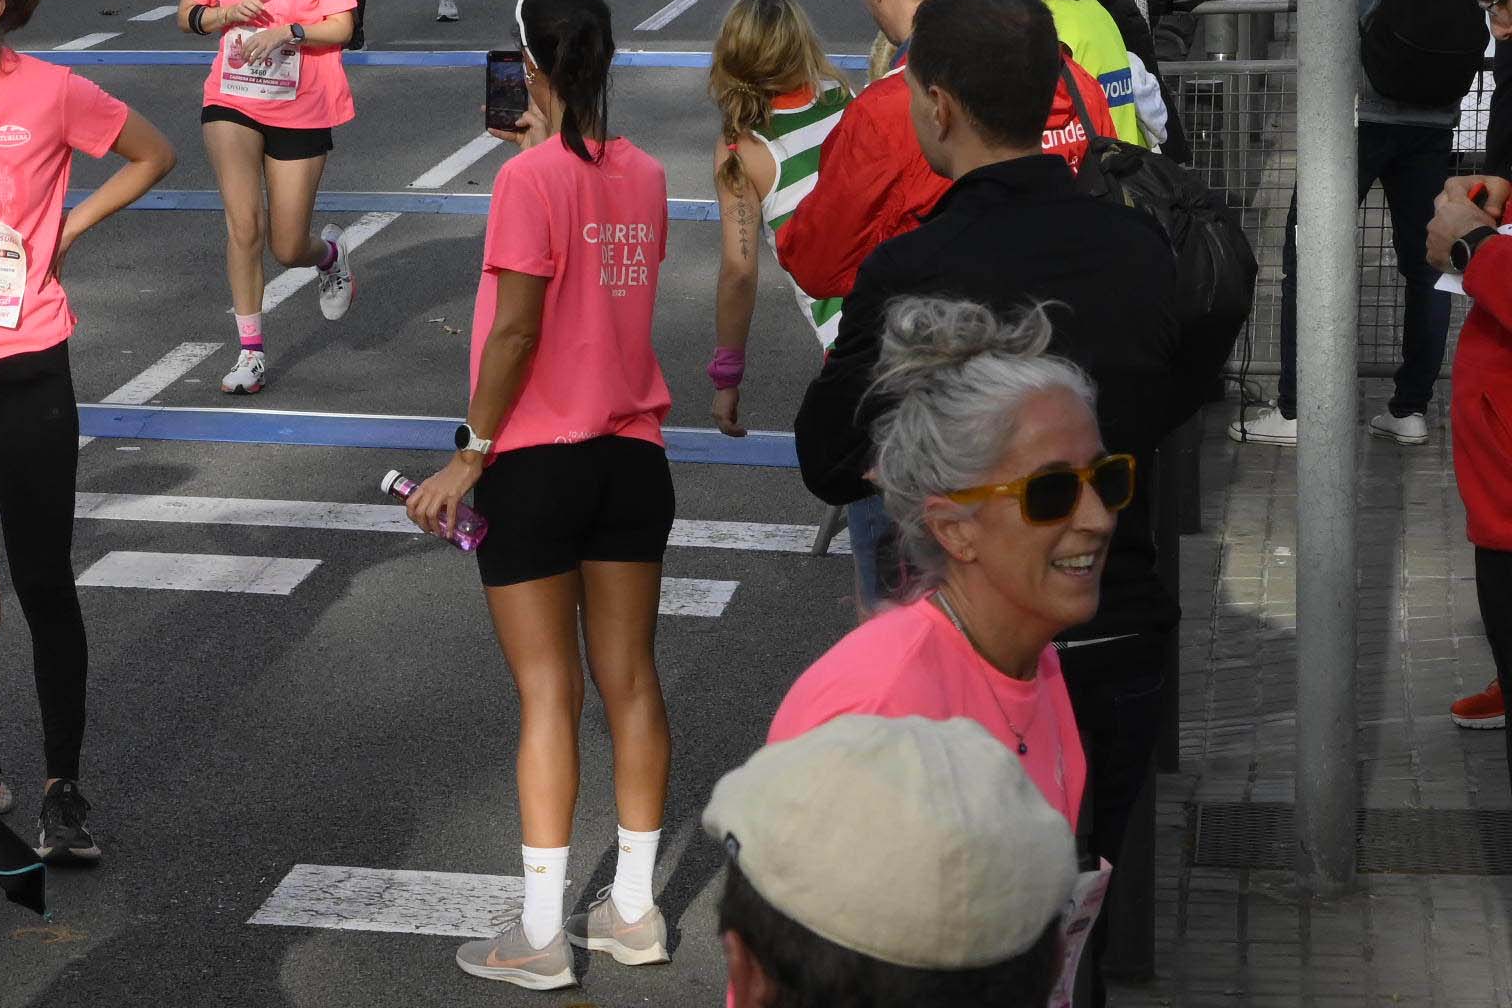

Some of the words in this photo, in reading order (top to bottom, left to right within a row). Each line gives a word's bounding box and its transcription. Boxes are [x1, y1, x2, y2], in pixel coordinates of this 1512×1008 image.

[1042, 121, 1086, 149] ande
[583, 223, 655, 244] CARRERA
[601, 245, 614, 264] DE
[623, 244, 646, 265] LA
